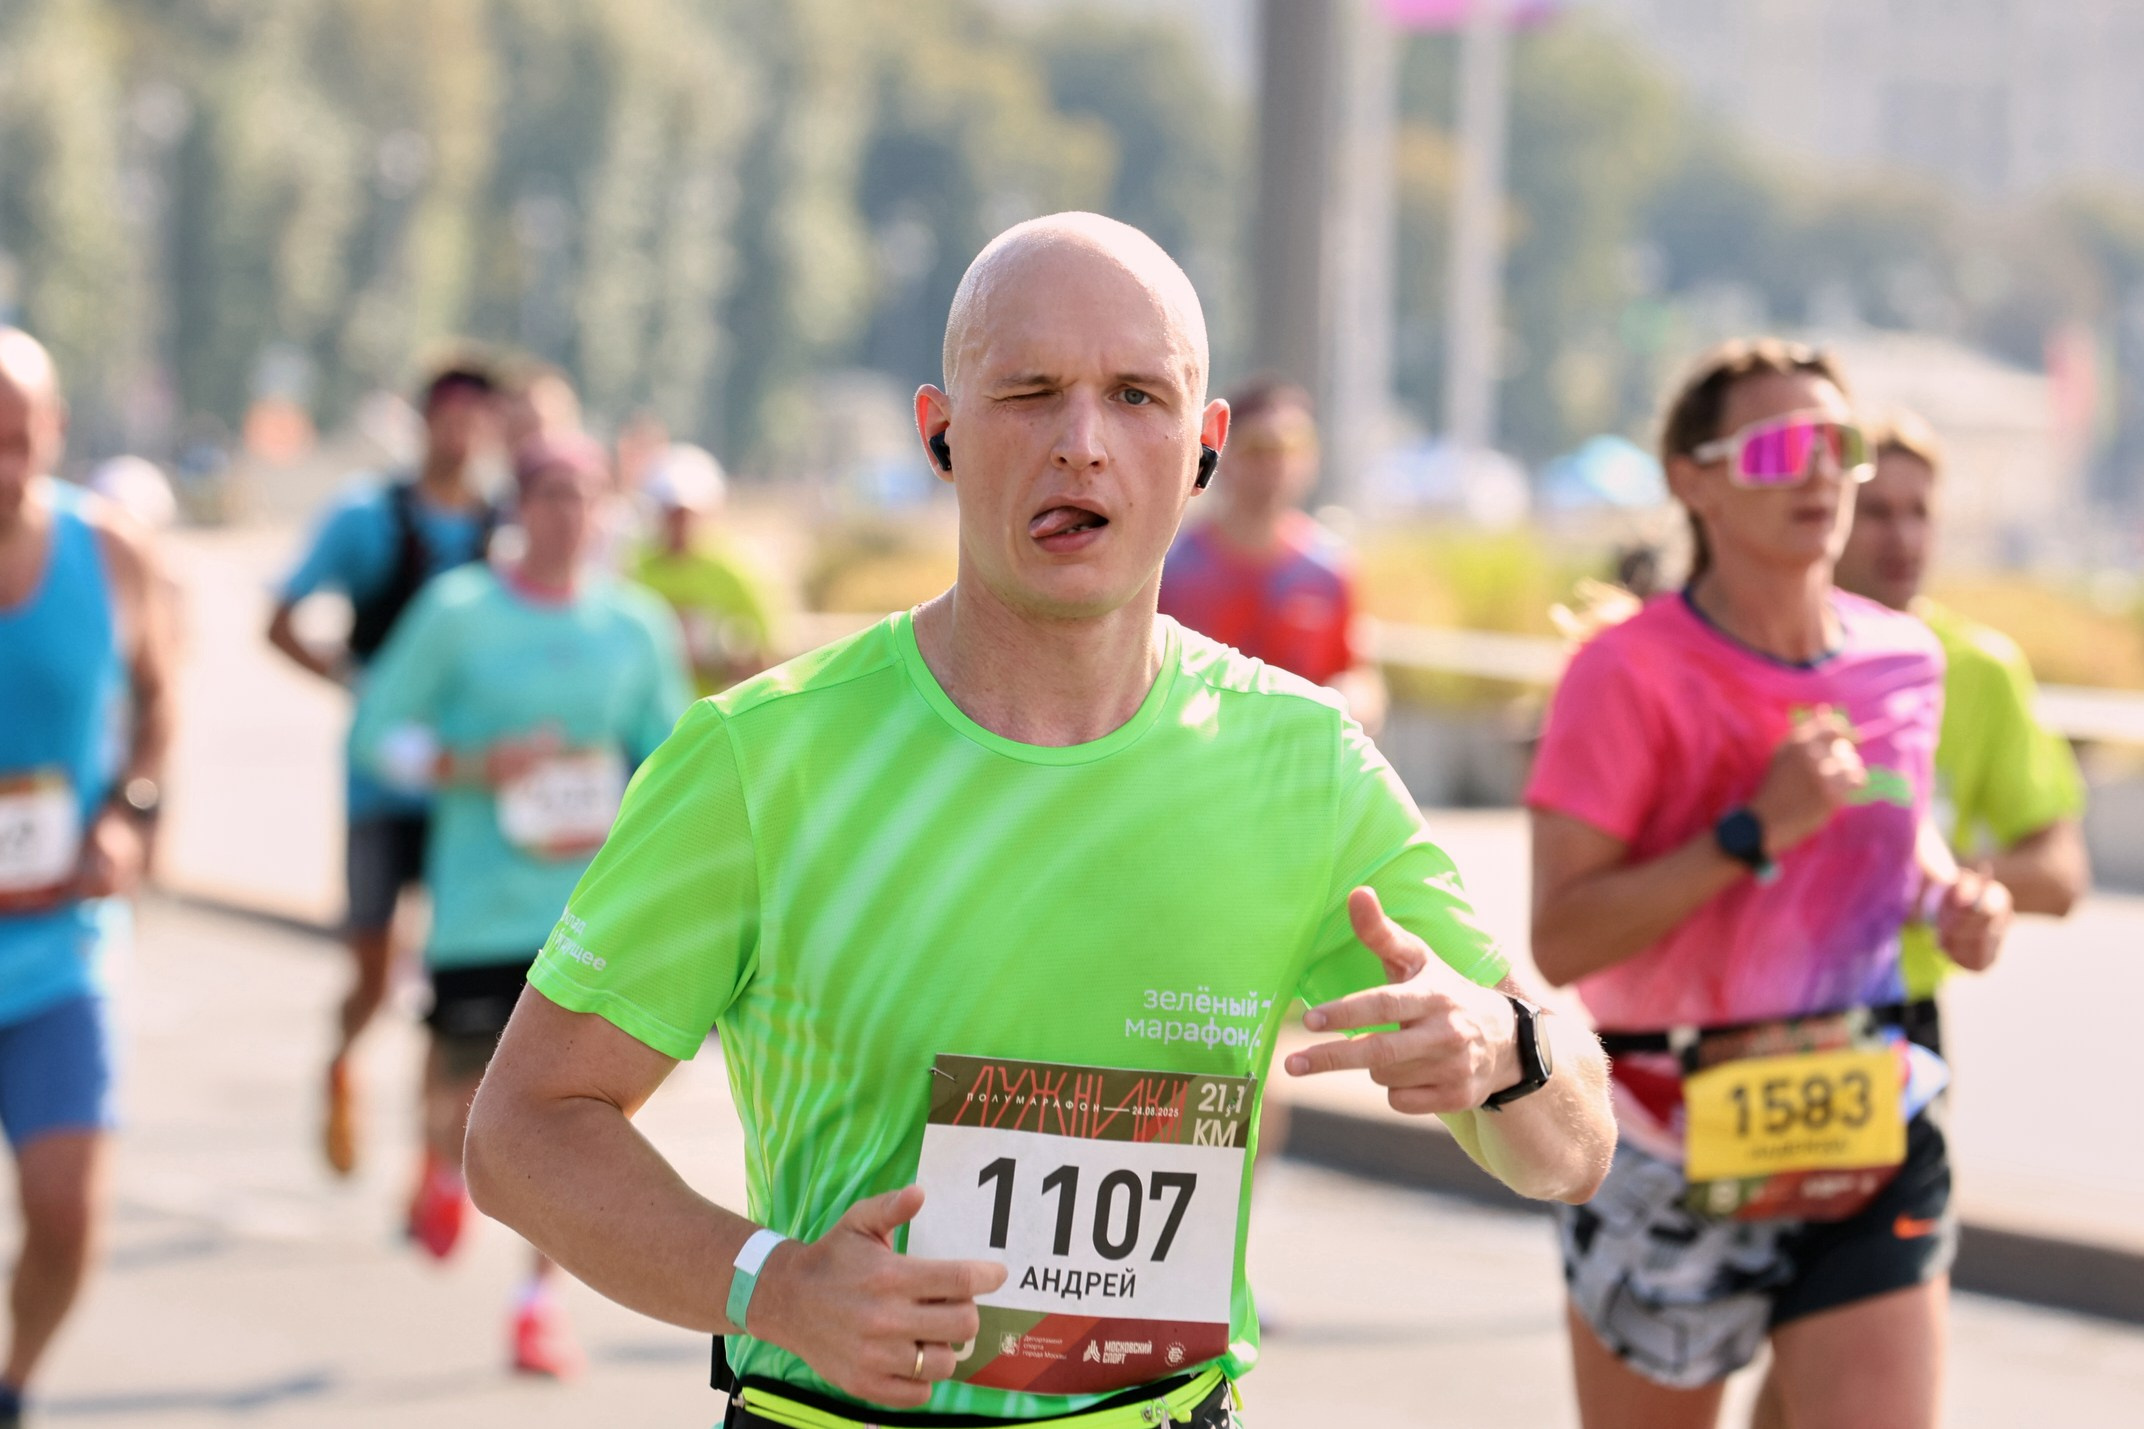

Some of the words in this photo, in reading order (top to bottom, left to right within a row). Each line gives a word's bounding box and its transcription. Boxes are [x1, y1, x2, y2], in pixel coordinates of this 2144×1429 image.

[1143, 985, 1258, 1017] зелёный
[1125, 1017, 1250, 1050] марафон
[966, 1092, 1100, 1113] ПОЛУМАРАФОН
[1730, 1070, 1873, 1138] 1583
[978, 1157, 1198, 1262] 1107
[1019, 1266, 1138, 1300] АНДРЕЙ
[1102, 1352, 1127, 1364] СПОРТ
[1104, 1340, 1153, 1355] МОСКОВСКИЙ
